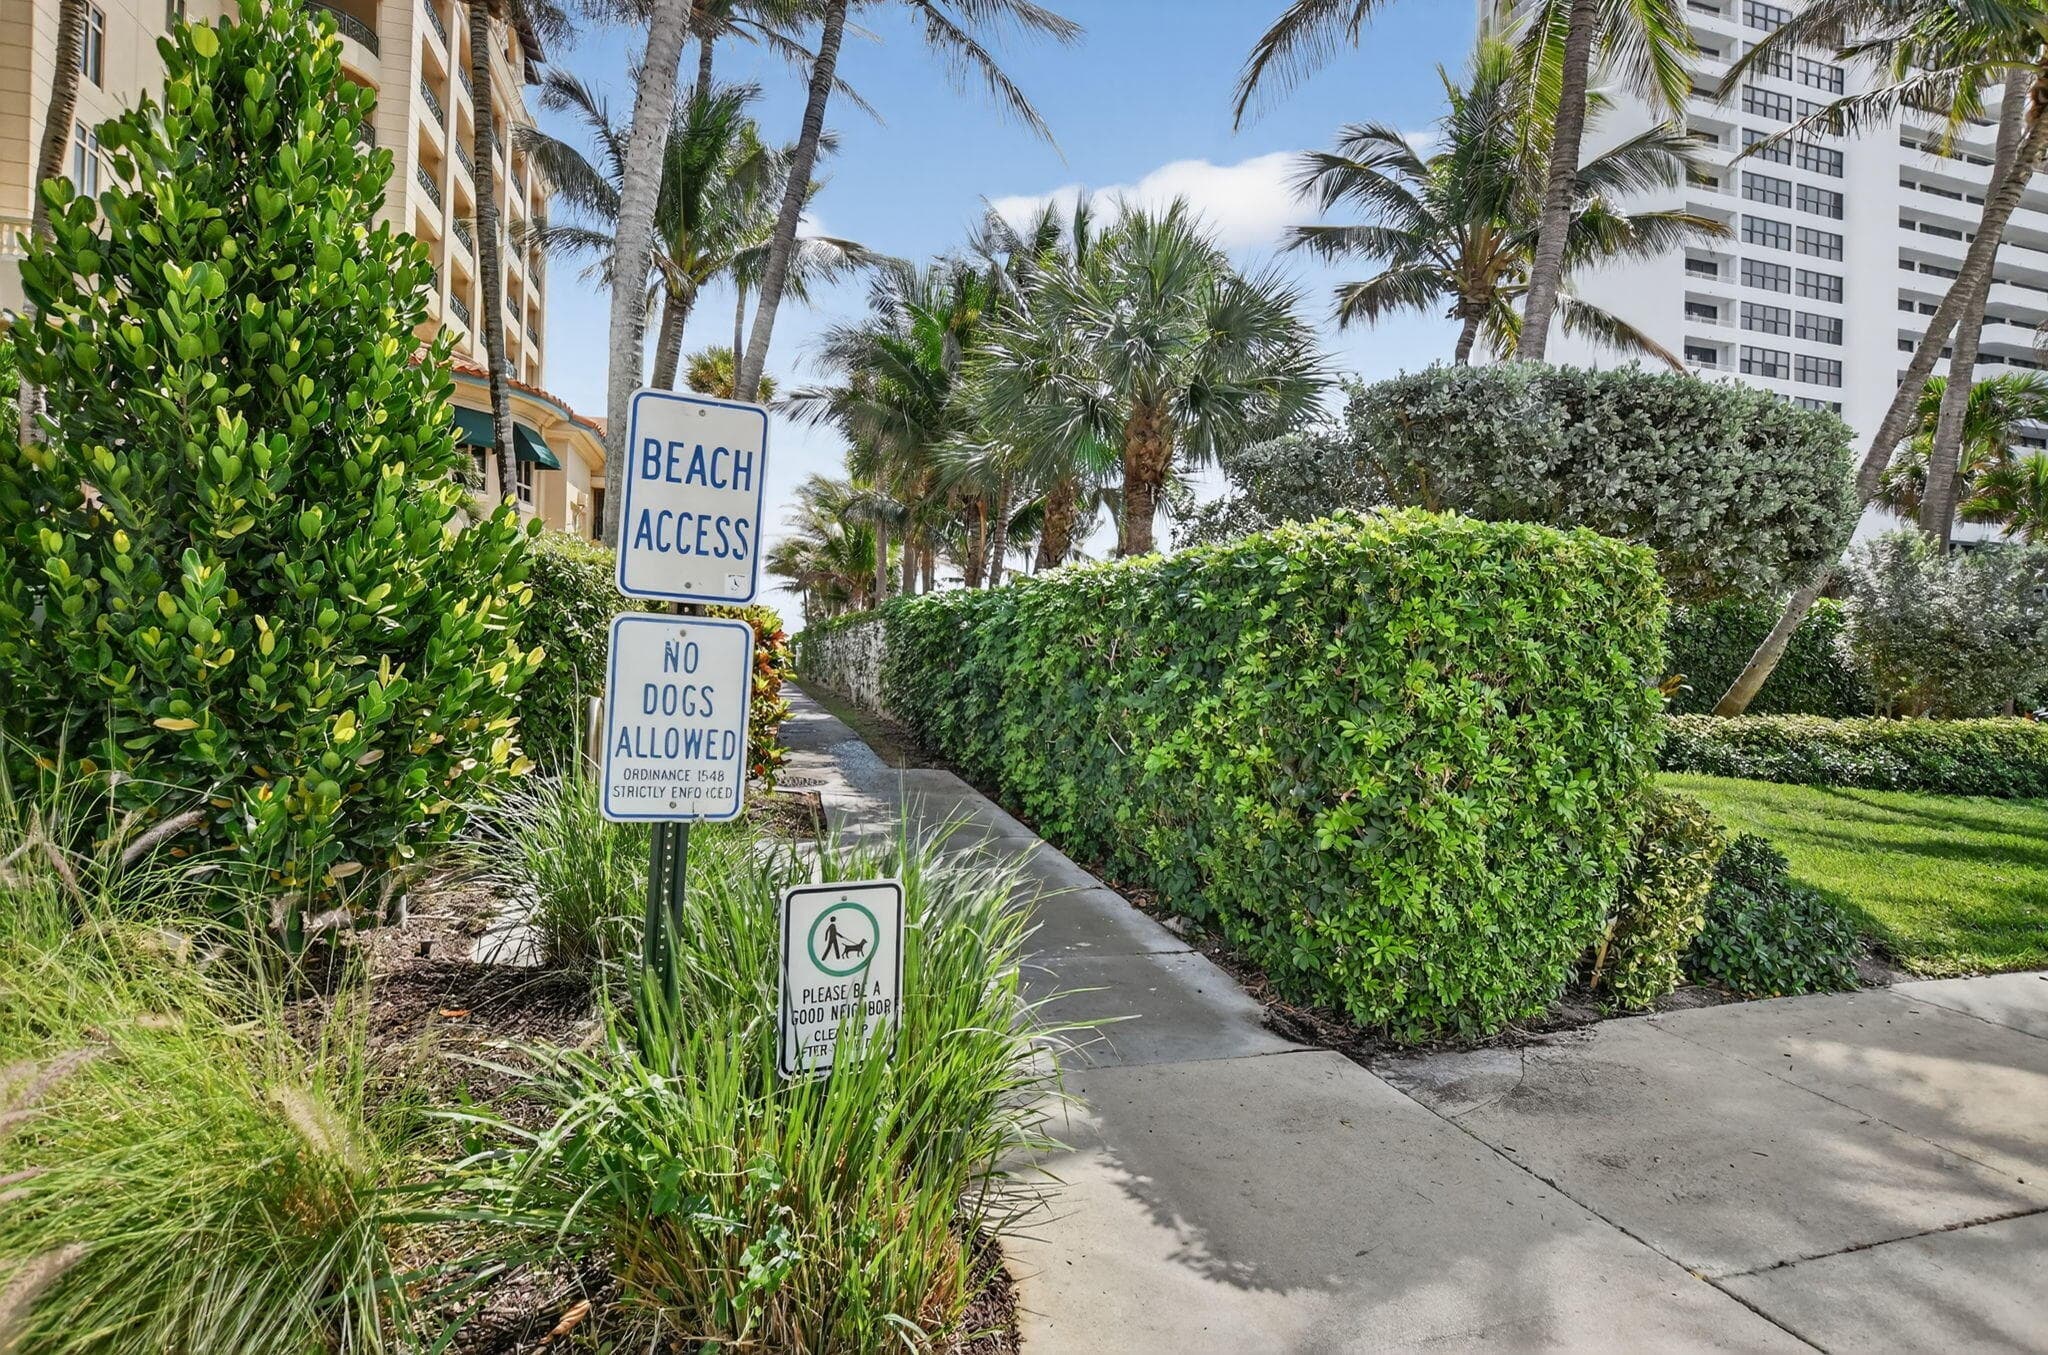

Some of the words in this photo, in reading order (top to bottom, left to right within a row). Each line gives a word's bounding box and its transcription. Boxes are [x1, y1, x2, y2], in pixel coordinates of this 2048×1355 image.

[641, 437, 753, 492] BEACH
[633, 508, 750, 561] ACCESS
[663, 641, 699, 674] NO
[643, 683, 715, 718] DOGS
[614, 726, 736, 761] ALLOWED
[623, 767, 691, 782] ORDINANCE
[697, 769, 725, 782] 1548
[612, 785, 666, 799] STRICTLY
[802, 984, 847, 1004] PLEASE
[873, 980, 881, 996] A
[791, 1007, 824, 1026] GOOD
